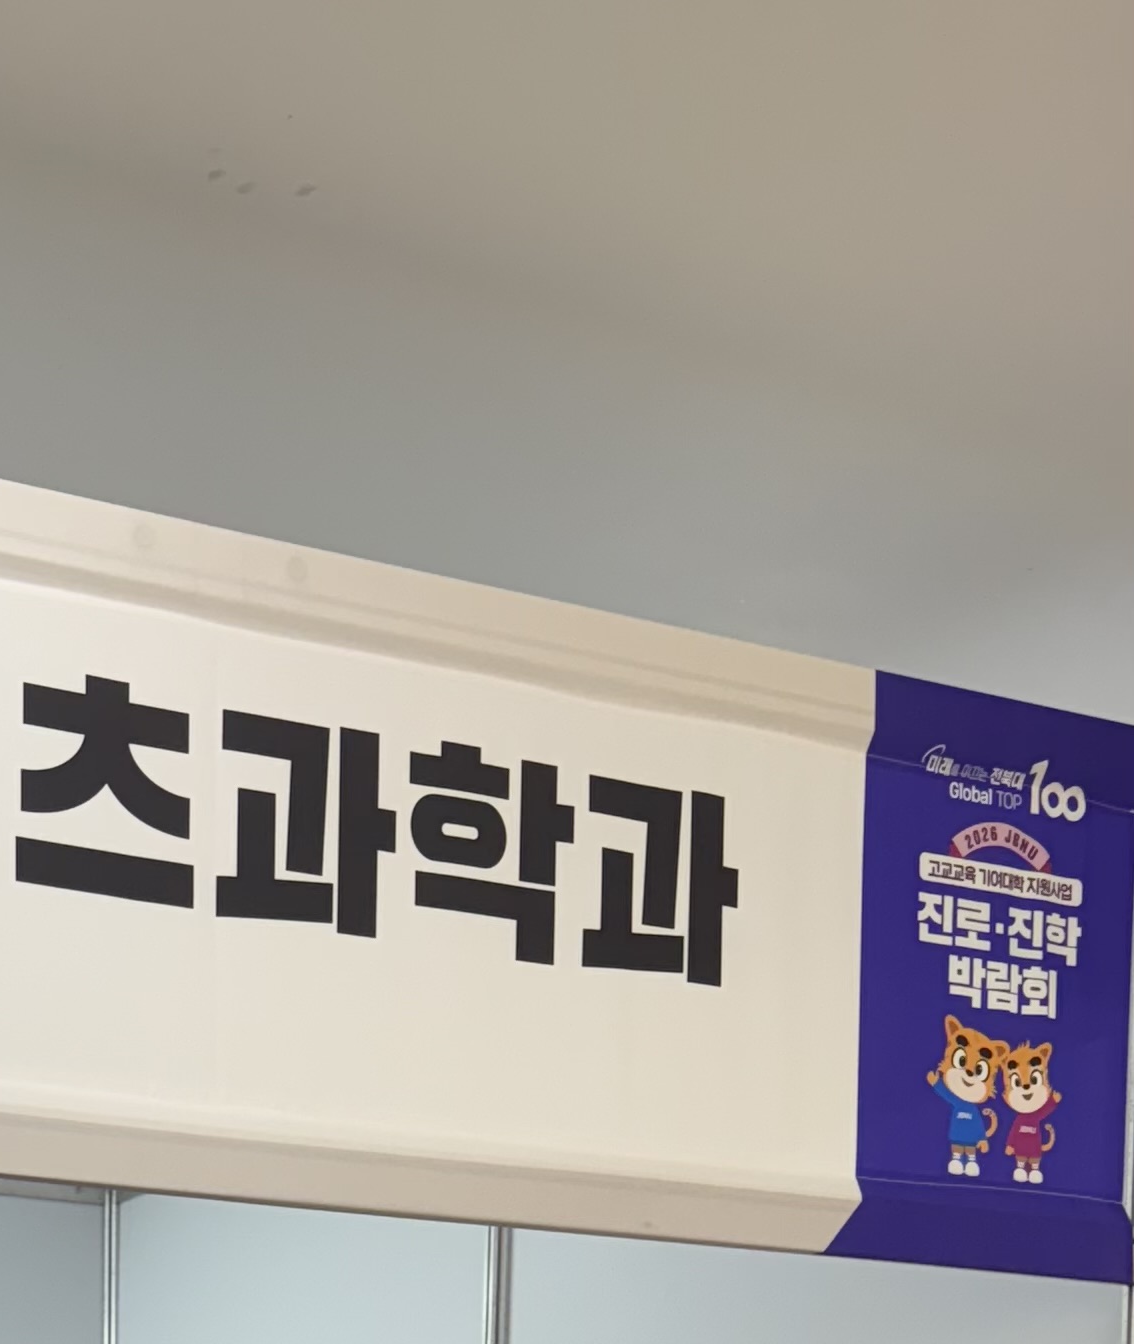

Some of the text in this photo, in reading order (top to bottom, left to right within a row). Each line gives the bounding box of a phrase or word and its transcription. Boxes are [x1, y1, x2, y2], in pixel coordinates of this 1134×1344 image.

[949, 760, 1087, 822] Global TOP 100
[990, 767, 1026, 790] 전북대
[964, 826, 1039, 861] 2026 JBNU
[928, 860, 1072, 901] 고교교육 기여대학 지원사업
[948, 954, 1058, 1020] 박람회
